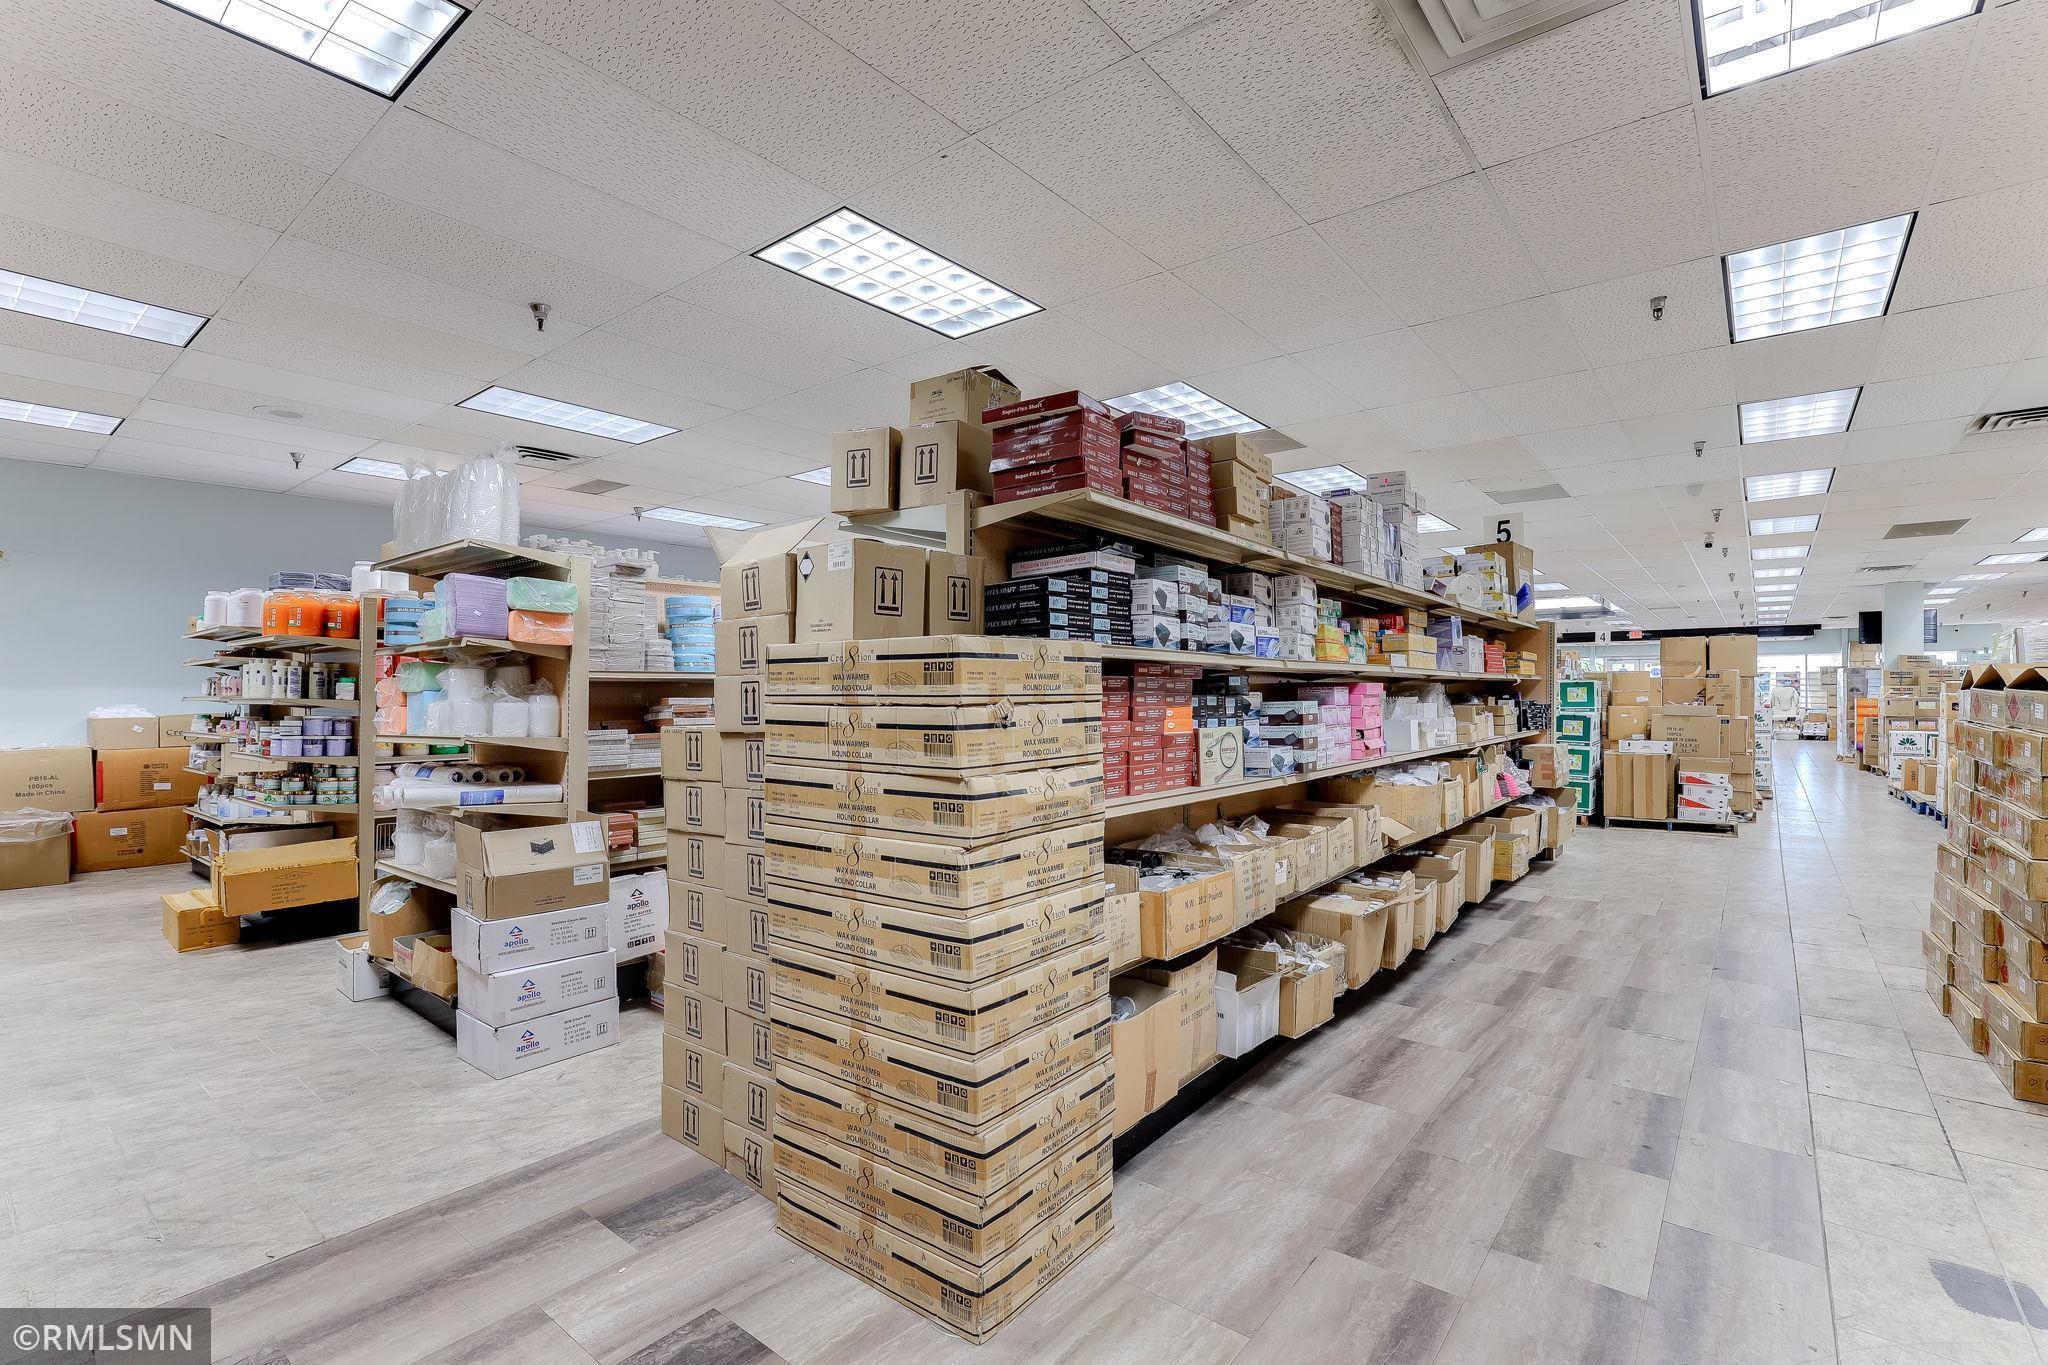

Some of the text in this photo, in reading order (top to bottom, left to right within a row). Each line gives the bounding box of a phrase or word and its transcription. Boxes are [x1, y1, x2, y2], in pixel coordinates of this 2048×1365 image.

[1002, 402, 1042, 415] Super-Flex Shaft
[1015, 471, 1040, 479] Super-Flex
[1016, 484, 1055, 496] Super-Flex Shaft
[1497, 520, 1511, 543] 5
[1600, 633, 1606, 642] 4
[830, 646, 872, 671] Cre8tion
[1020, 645, 1060, 671] Cre8tion
[830, 713, 872, 738] Cre8tion
[1018, 710, 1058, 736] Cre8tion
[851, 751, 872, 759] COLLAR
[1023, 749, 1041, 758] ROUND
[836, 777, 878, 802] Cre8tion
[838, 802, 876, 813] WAX WARMER
[1032, 810, 1069, 822] ROUND COLLAR
[1036, 801, 1068, 812] WAX WARMER
[837, 813, 879, 824] ROUND COLLAR
[834, 842, 876, 866] Cre8tion
[1022, 838, 1063, 865] Cre8tion
[850, 869, 873, 878] WARMER
[1028, 863, 1064, 876] WAX WARMER
[835, 878, 877, 890] ROUND COLLAR
[1027, 874, 1066, 888] ROUND COLLAR
[627, 900, 649, 911] apollo
[1208, 891, 1223, 901] Pounds
[835, 908, 877, 932] Cre8tion
[1026, 904, 1066, 933] Cre8tion
[1208, 913, 1223, 924] Pounds
[504, 938, 528, 948] apollo
[837, 931, 874, 945] WAX WARMER
[1030, 938, 1067, 957] ROUND COLLAR
[1032, 929, 1066, 945] WAX WARMER
[836, 942, 878, 957] ROUND COLLAR
[1030, 969, 1069, 998] Cre8tion
[518, 991, 540, 1002] apollo
[841, 995, 879, 1011] WAX WARMER
[1035, 992, 1069, 1011] WAX WARMER
[839, 1005, 882, 1023] ROUND COLLAR
[1033, 1002, 1070, 1022] ROUND COLLAR
[516, 1041, 539, 1053] apollo
[839, 1038, 882, 1061] Cre8tion
[1032, 1034, 1070, 1064] Cre8tion
[842, 1059, 881, 1077] WAX WARMER
[1035, 1066, 1072, 1090] ROUND COLLAR
[1036, 1056, 1070, 1078] WAX WARMER
[841, 1069, 884, 1090] ROUND COLLAR
[844, 1103, 890, 1126] Cre8tion
[1039, 1097, 1077, 1128] Cre8tion
[847, 1124, 887, 1143] WAX WARMER
[1042, 1127, 1078, 1156] ROUND COLLAR
[1043, 1118, 1077, 1143] WAX WARMER
[846, 1134, 890, 1156] ROUND COLLAR
[843, 1167, 887, 1189] Cre8tion
[1035, 1161, 1073, 1191] Cre8tion
[846, 1185, 886, 1207] WAX WARMER
[1037, 1189, 1074, 1219] ROUND COLLAR
[1039, 1180, 1072, 1208] WAX WARMER
[845, 1194, 889, 1220] ROUND COLLAR
[842, 1229, 887, 1253] Cre8tion
[1034, 1225, 1071, 1258] Cre8tion
[845, 1248, 885, 1272] WAX WARMER
[1039, 1243, 1072, 1274] WAX WARMER
[844, 1256, 887, 1284] ROUND COLLAR
[1038, 1253, 1074, 1287] ROUND COLLAR
